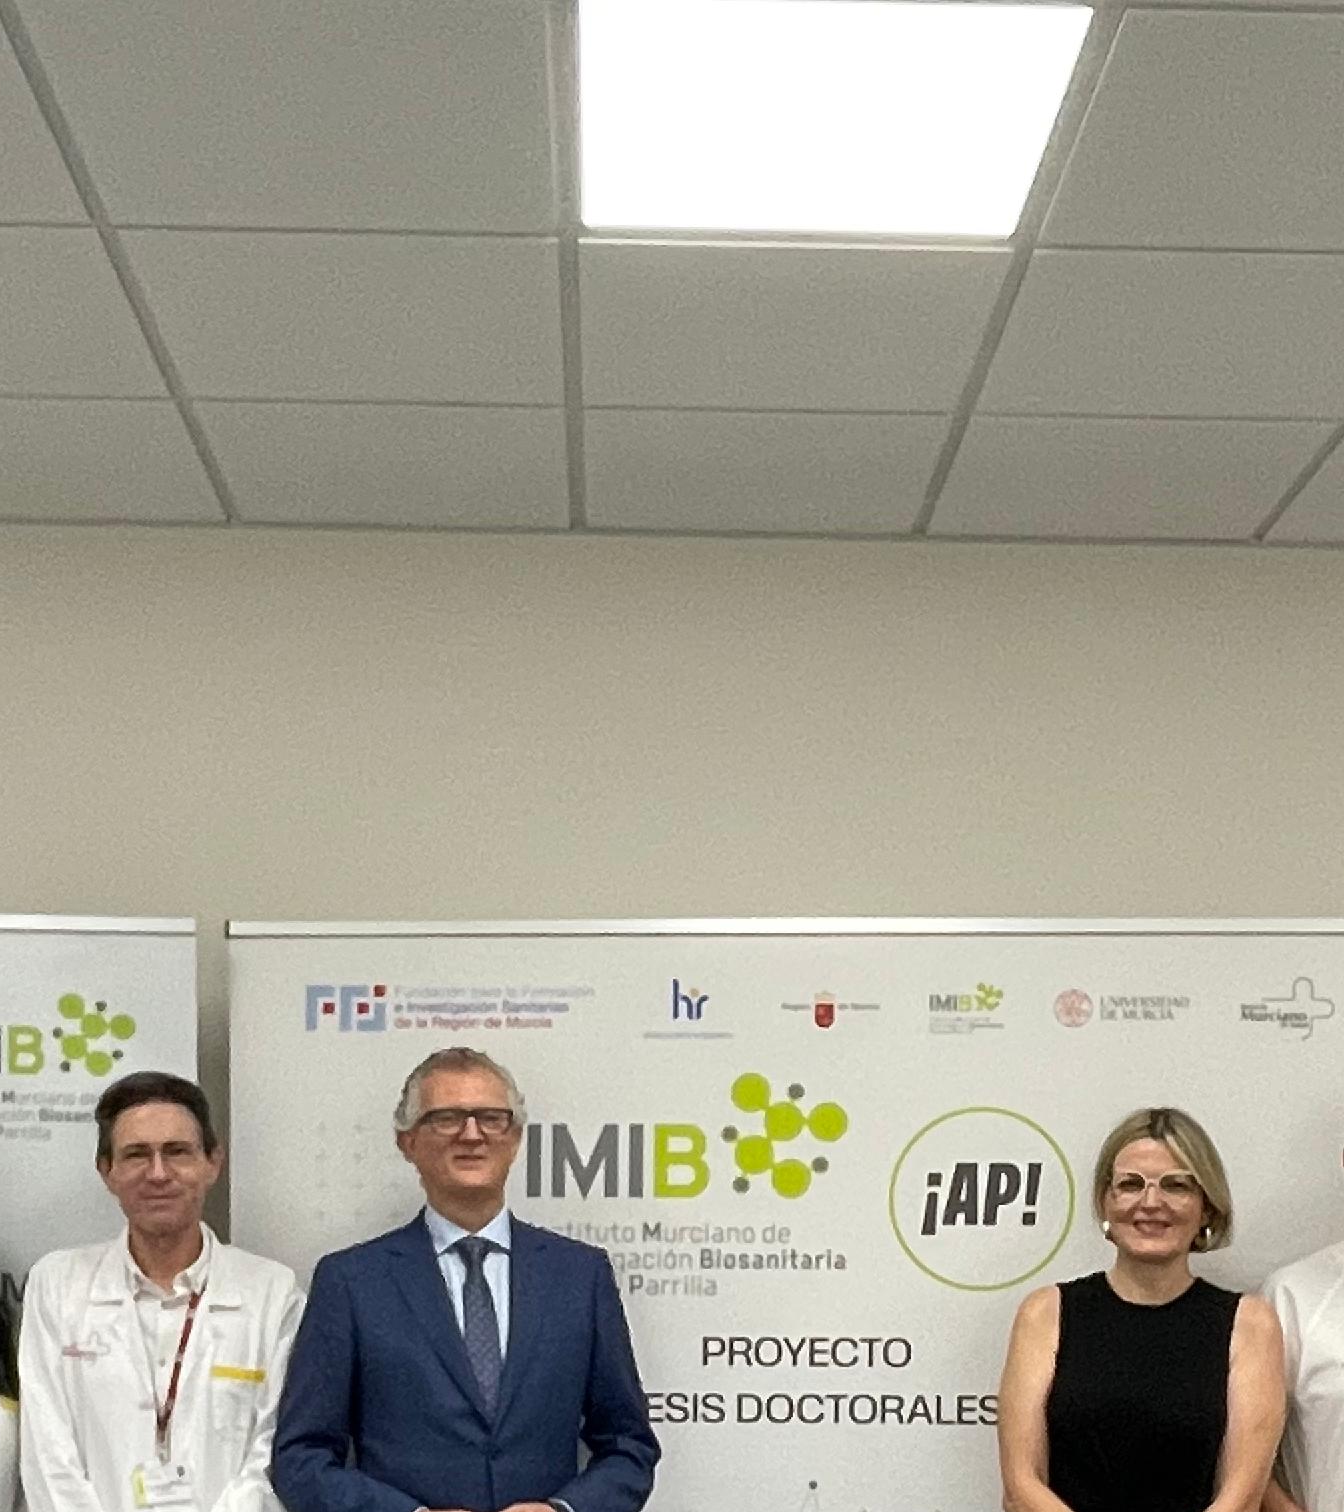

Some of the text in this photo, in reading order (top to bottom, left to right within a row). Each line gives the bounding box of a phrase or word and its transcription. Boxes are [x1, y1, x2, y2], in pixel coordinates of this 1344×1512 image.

[526, 1123, 711, 1200] IMIB
[921, 1162, 1043, 1236] ¡AP!
[642, 1221, 757, 1244] Murciano
[761, 1223, 792, 1244] de
[699, 1247, 849, 1270] Biosanitaria
[701, 1335, 913, 1369] PROYECTO
[646, 1391, 999, 1426] ESIS DOCTORALES
